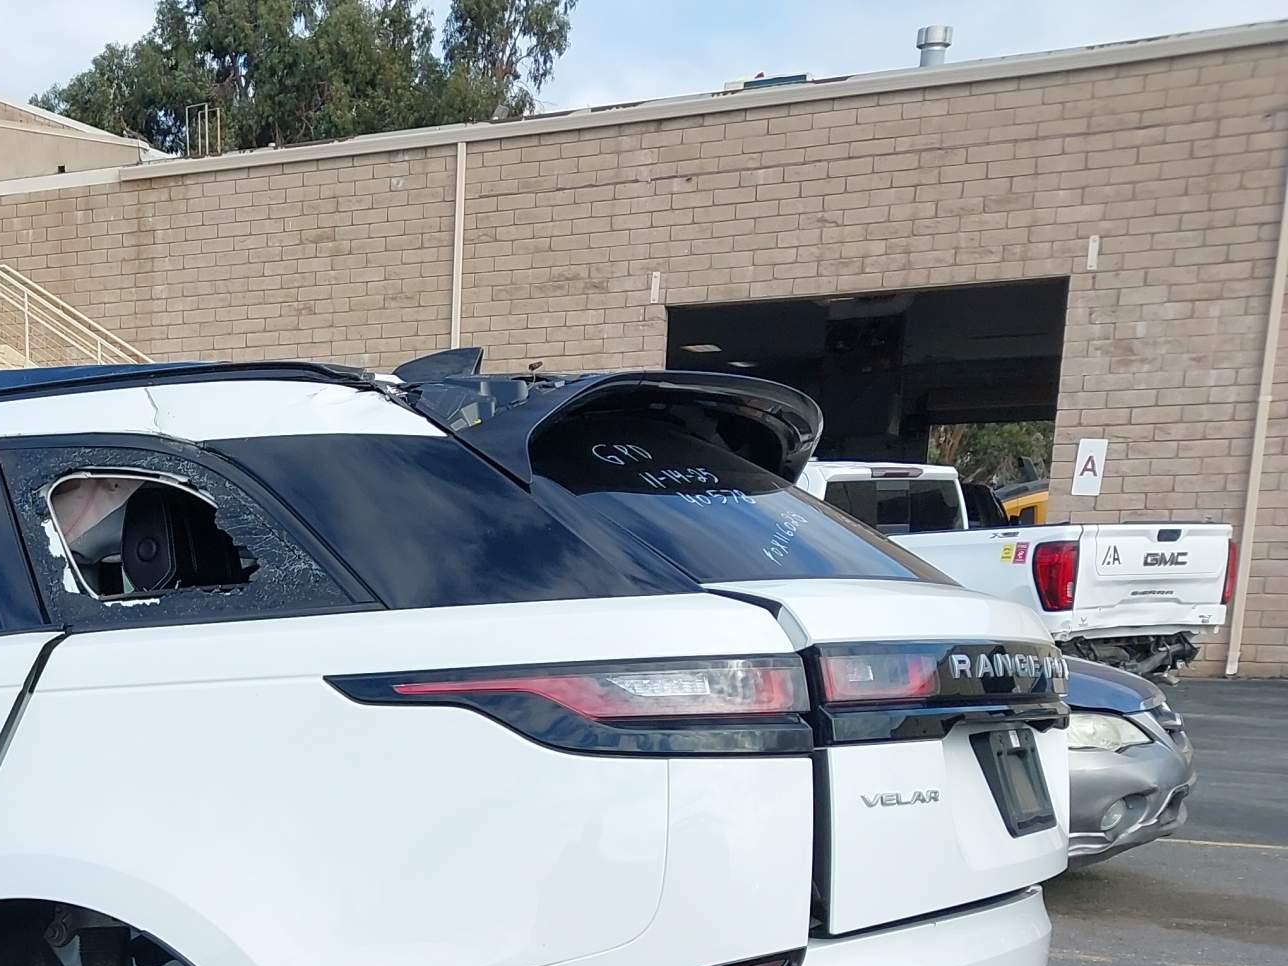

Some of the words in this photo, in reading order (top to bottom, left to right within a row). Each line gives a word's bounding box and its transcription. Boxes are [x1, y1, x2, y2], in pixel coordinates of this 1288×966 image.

[1079, 455, 1098, 477] A
[1143, 551, 1189, 567] GMC
[948, 652, 1042, 679] RANGE
[860, 789, 941, 809] VELAR
